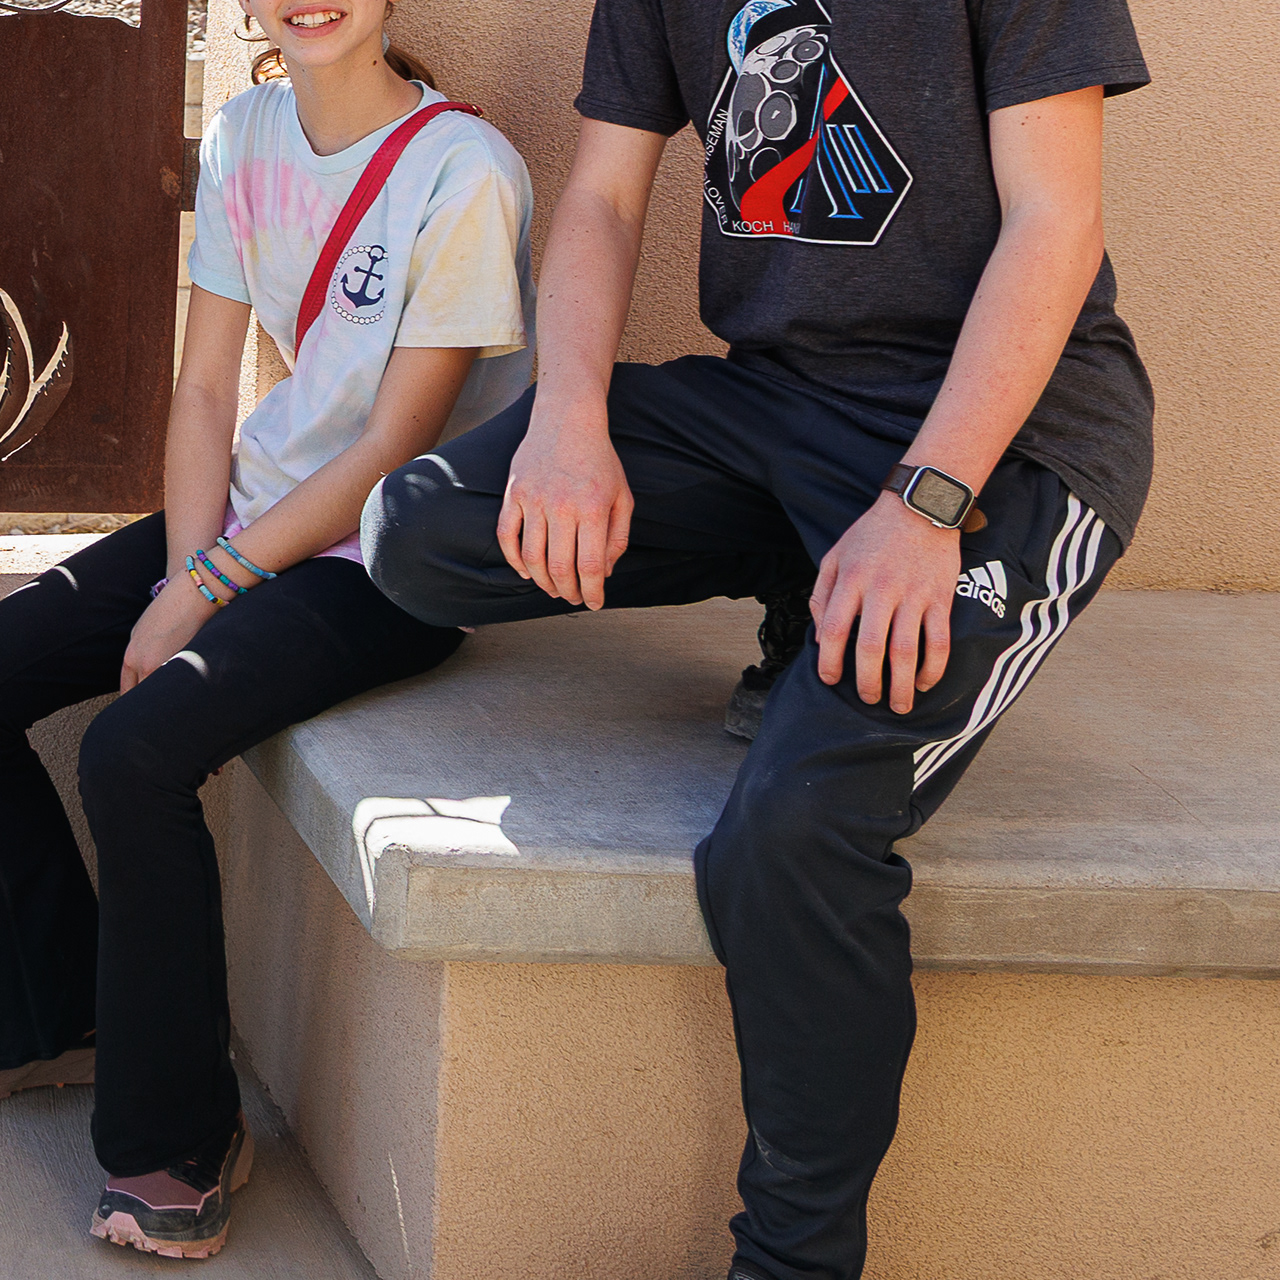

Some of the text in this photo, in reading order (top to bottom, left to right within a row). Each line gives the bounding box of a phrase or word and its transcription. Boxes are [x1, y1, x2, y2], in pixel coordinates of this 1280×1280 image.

[704, 108, 728, 166] ISEMAN
[731, 219, 775, 233] KOCH
[955, 581, 1007, 619] didas
